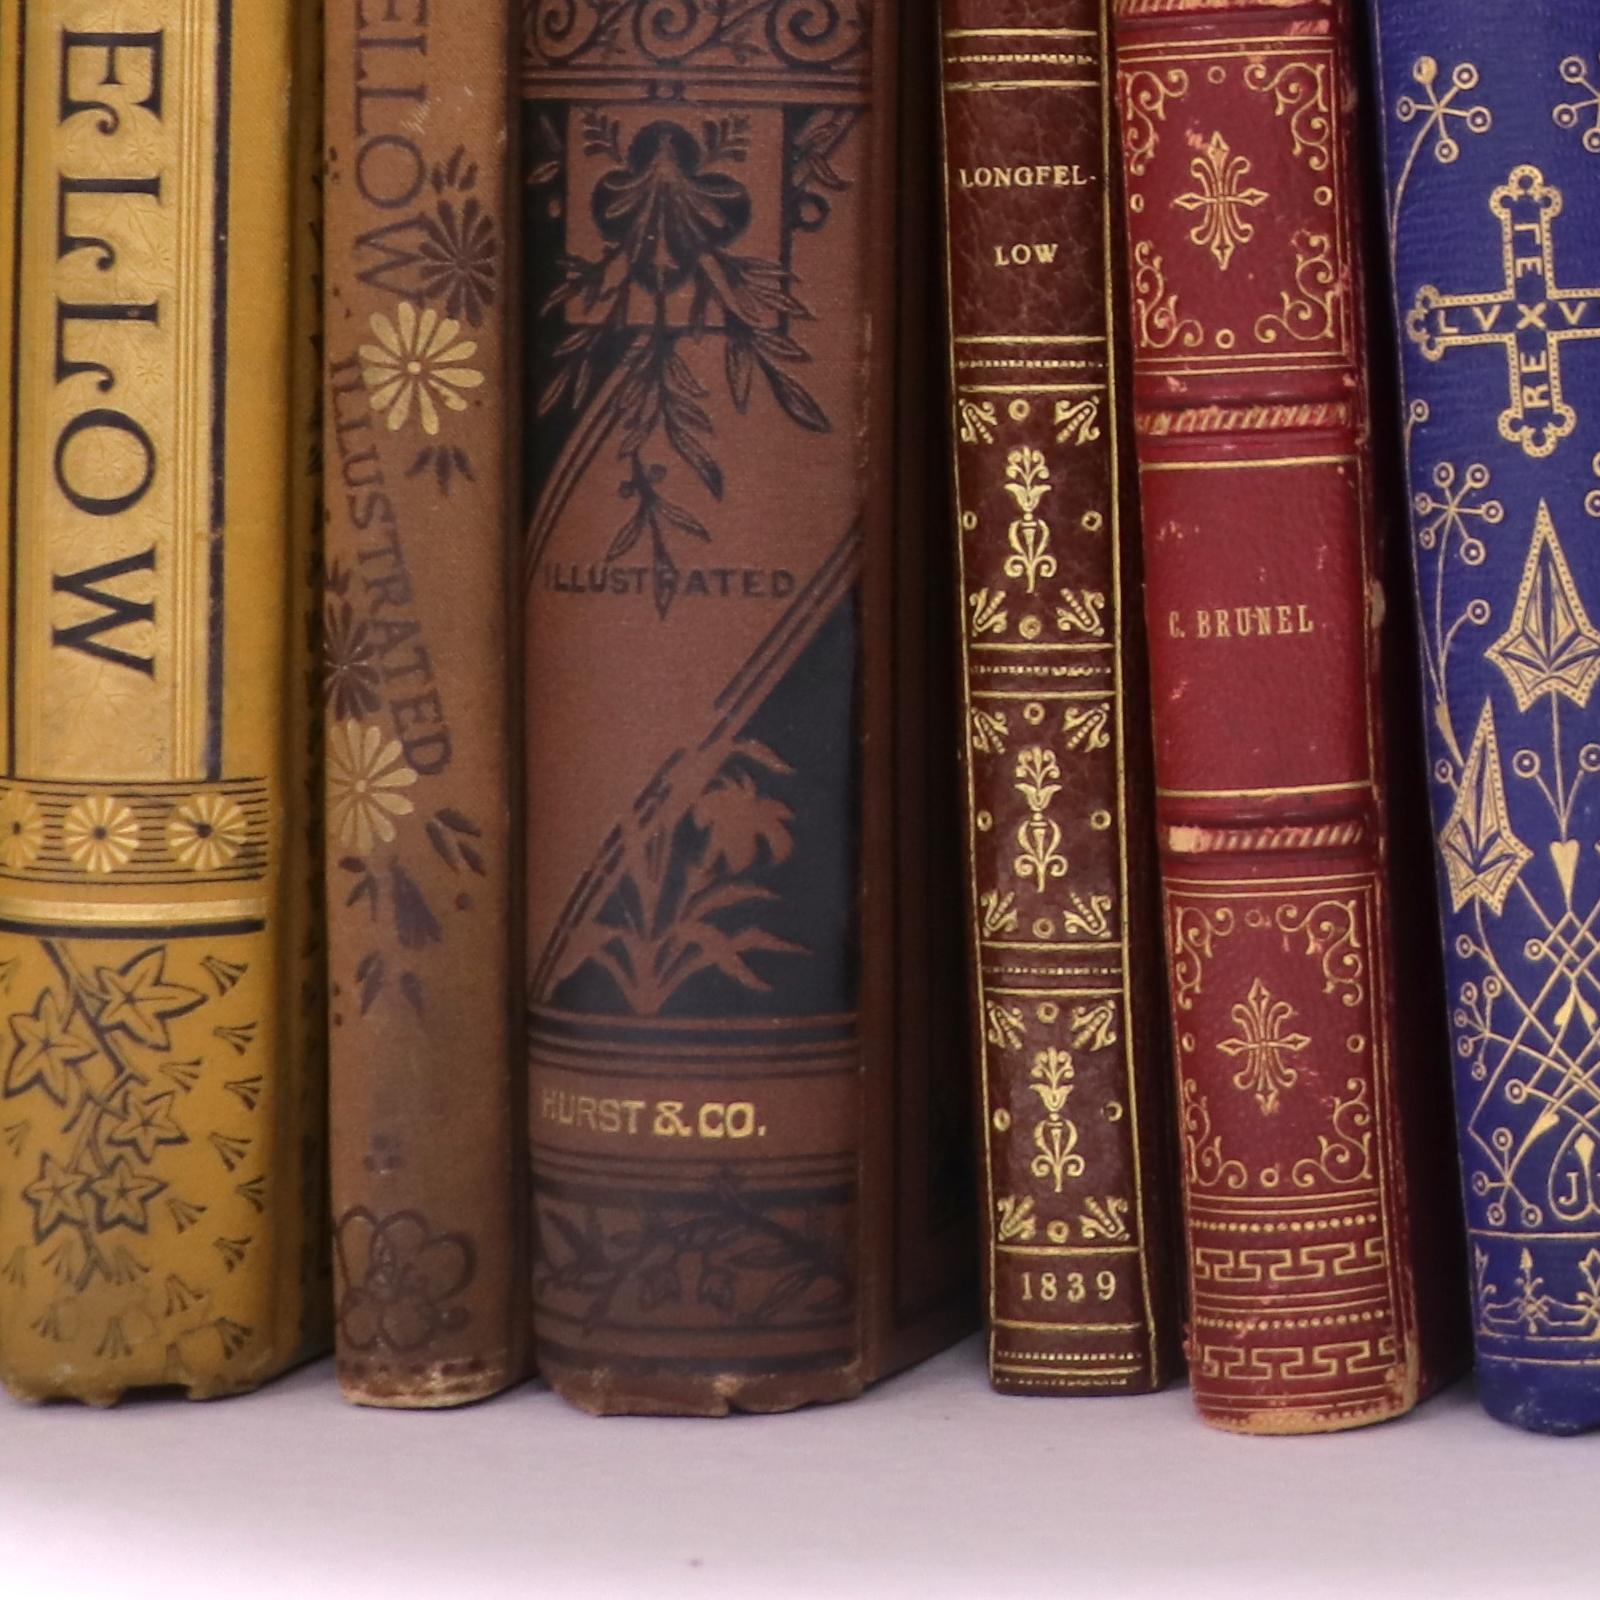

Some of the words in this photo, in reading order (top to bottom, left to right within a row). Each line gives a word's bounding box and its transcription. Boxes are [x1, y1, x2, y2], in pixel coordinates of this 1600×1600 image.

[960, 163, 1097, 190] LONGFEL-
[994, 243, 1058, 267] LOW
[330, 356, 453, 777] ILLUSTRATED
[546, 565, 797, 600] ILLUSTRATED
[1196, 604, 1315, 640] BRUNEL
[543, 1090, 647, 1135] HURST
[653, 1100, 692, 1138] &
[698, 1101, 768, 1139] CO.
[1020, 1271, 1117, 1301] 1839
